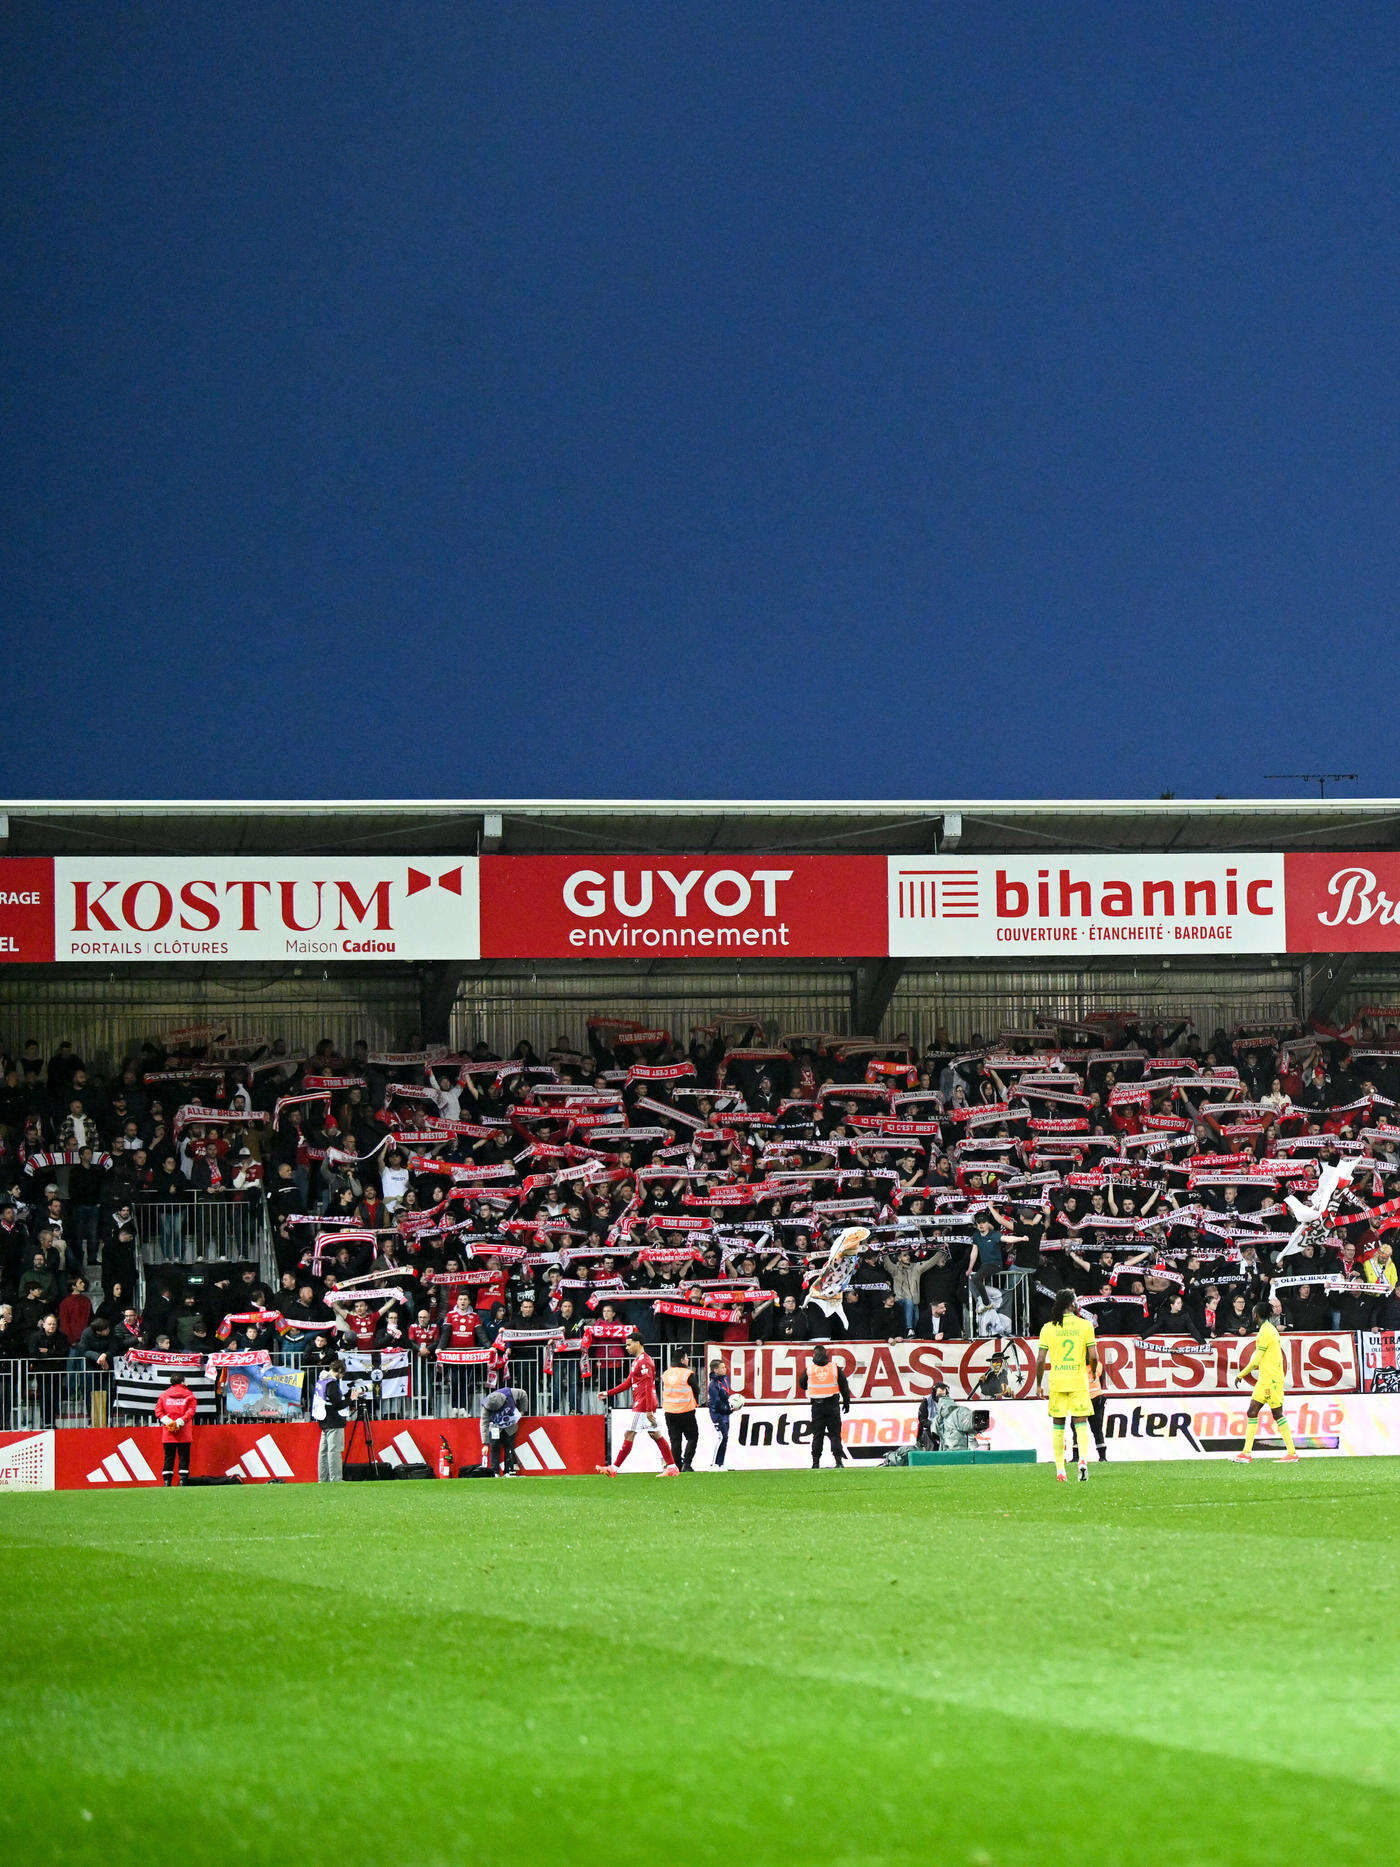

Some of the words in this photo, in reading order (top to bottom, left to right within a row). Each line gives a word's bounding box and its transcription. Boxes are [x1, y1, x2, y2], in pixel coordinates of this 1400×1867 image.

[562, 869, 795, 918] GUYOT
[995, 868, 1274, 918] bihannic
[69, 880, 394, 932] KOSTUM
[568, 922, 790, 947] environnement
[996, 927, 1078, 942] COUVERTURE
[1174, 925, 1233, 941] BARDAGE
[71, 942, 142, 955] PORTAILS
[153, 939, 229, 955] CLÔTURES
[286, 939, 338, 954] Maison
[343, 939, 396, 954] Cadiou
[399, 1131, 419, 1141] STADE
[419, 1129, 449, 1140] BRESTOIS
[896, 1122, 914, 1132] C'EST
[915, 1122, 936, 1132] BREST
[713, 1292, 733, 1301] STADE
[743, 1289, 773, 1299] BRESTOIS
[672, 1304, 692, 1316] STADE
[690, 1306, 719, 1320] BRESTOIS
[440, 1351, 462, 1362] STADE
[461, 1350, 491, 1362] BRESTOIS
[1061, 1338, 1076, 1362] 2
